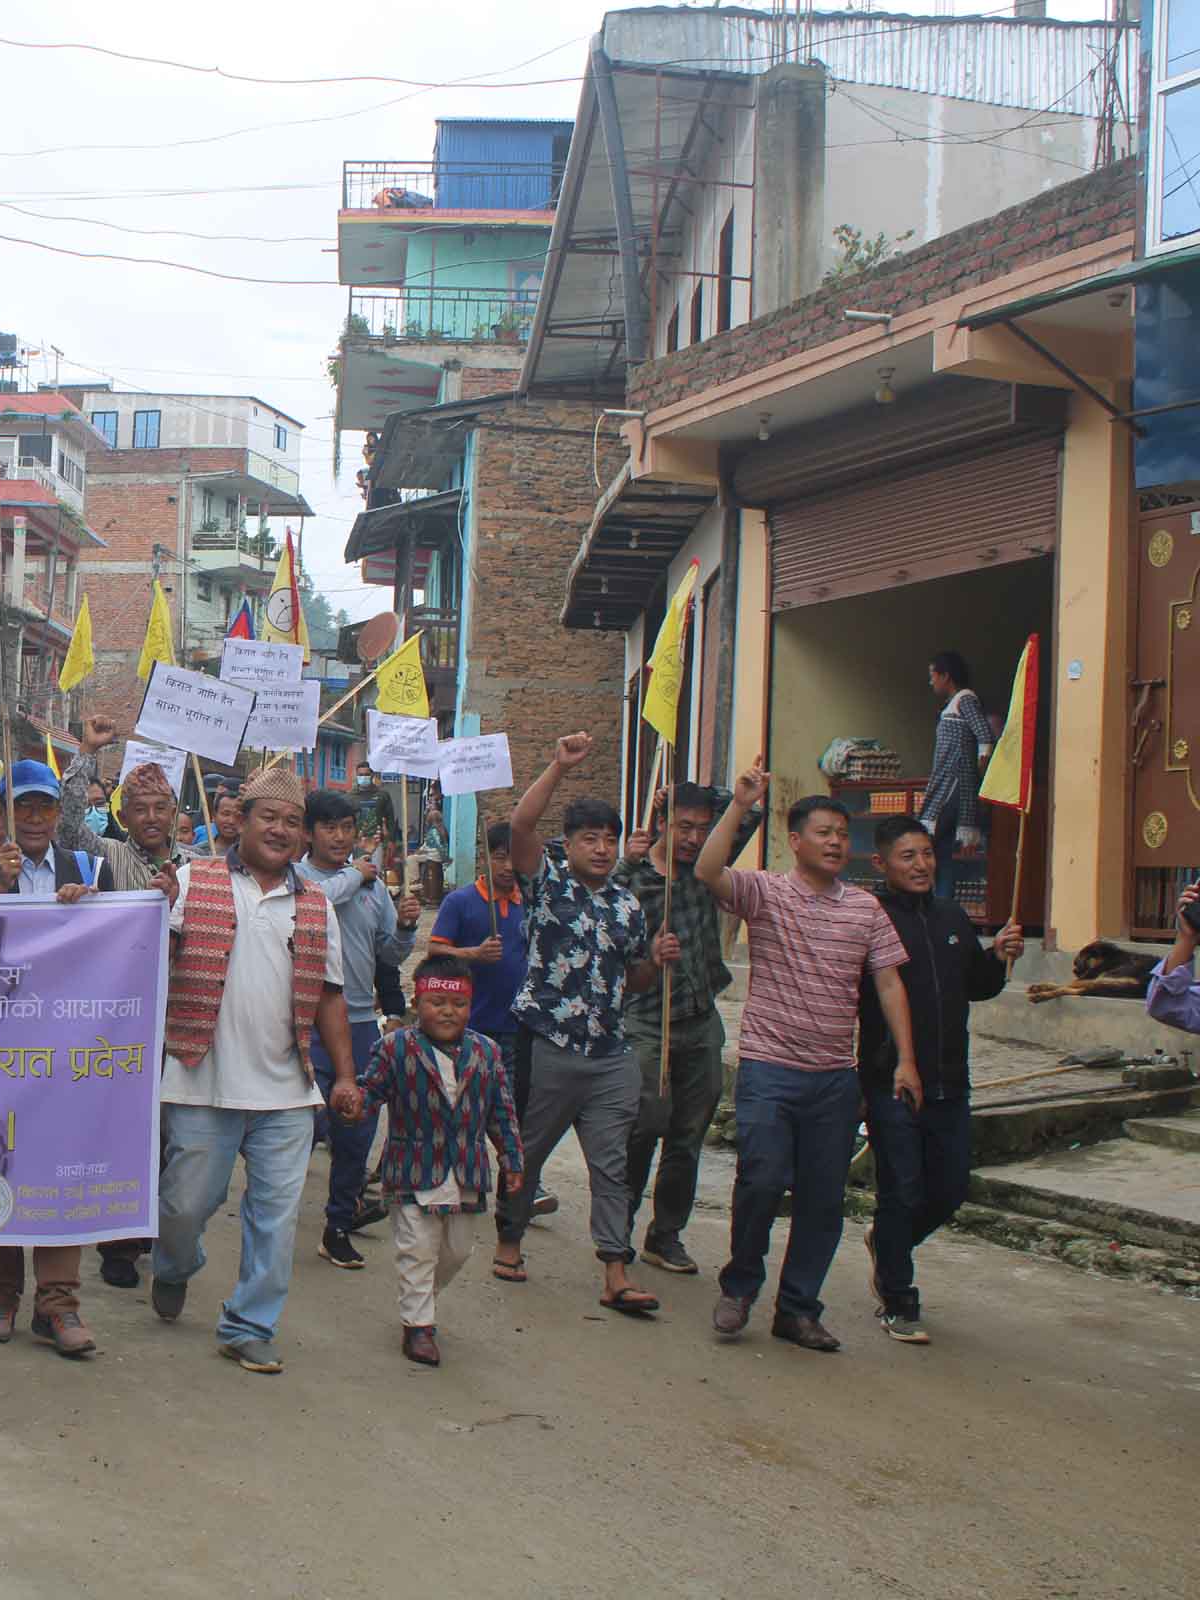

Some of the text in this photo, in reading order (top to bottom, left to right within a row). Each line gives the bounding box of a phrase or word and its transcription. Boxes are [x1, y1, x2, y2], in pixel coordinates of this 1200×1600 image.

[428, 977, 461, 991] किरात
[52, 998, 142, 1019] आधारमा
[68, 1035, 147, 1081] प्रदेस
